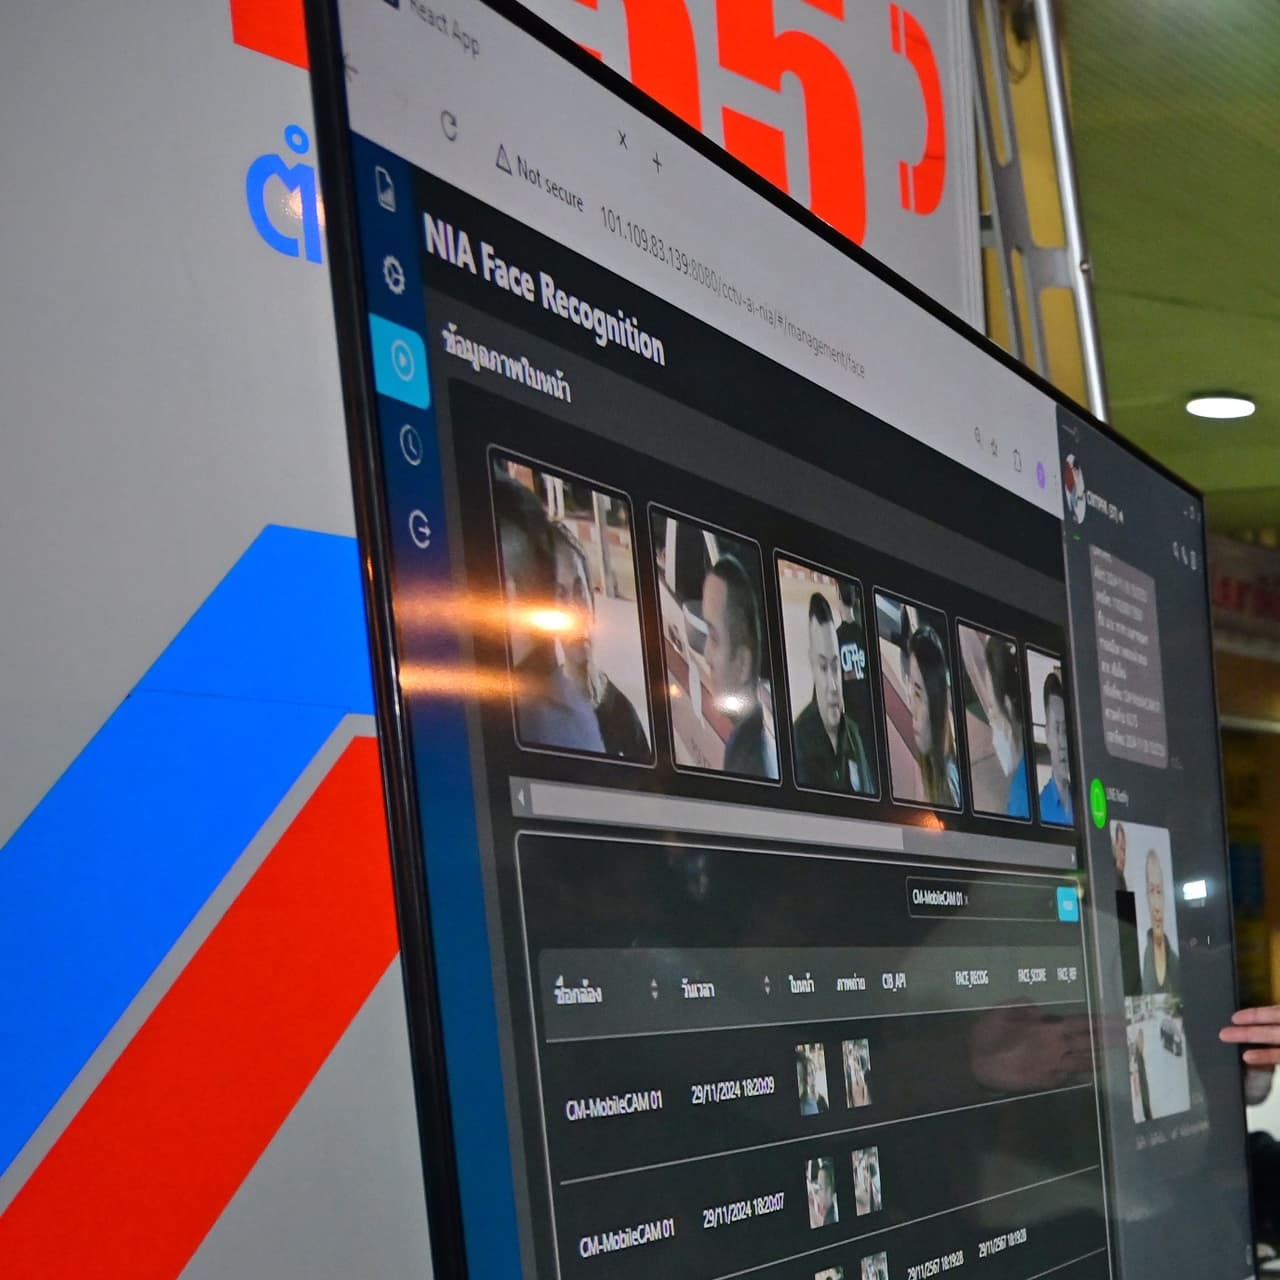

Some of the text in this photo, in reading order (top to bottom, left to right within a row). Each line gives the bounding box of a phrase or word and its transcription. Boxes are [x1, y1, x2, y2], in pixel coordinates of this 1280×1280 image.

[452, 19, 481, 57] App
[517, 155, 542, 189] Not
[545, 173, 585, 213] secure
[423, 211, 666, 367] NIA Face Recognition
[912, 889, 956, 906] CM-MobileCAM
[566, 1090, 664, 1121] CM-MobileCAM 01
[691, 1079, 741, 1104] 29/11/2024
[703, 1201, 752, 1229] 29/11/2024
[580, 1218, 676, 1258] CM-MobileCAM 01
